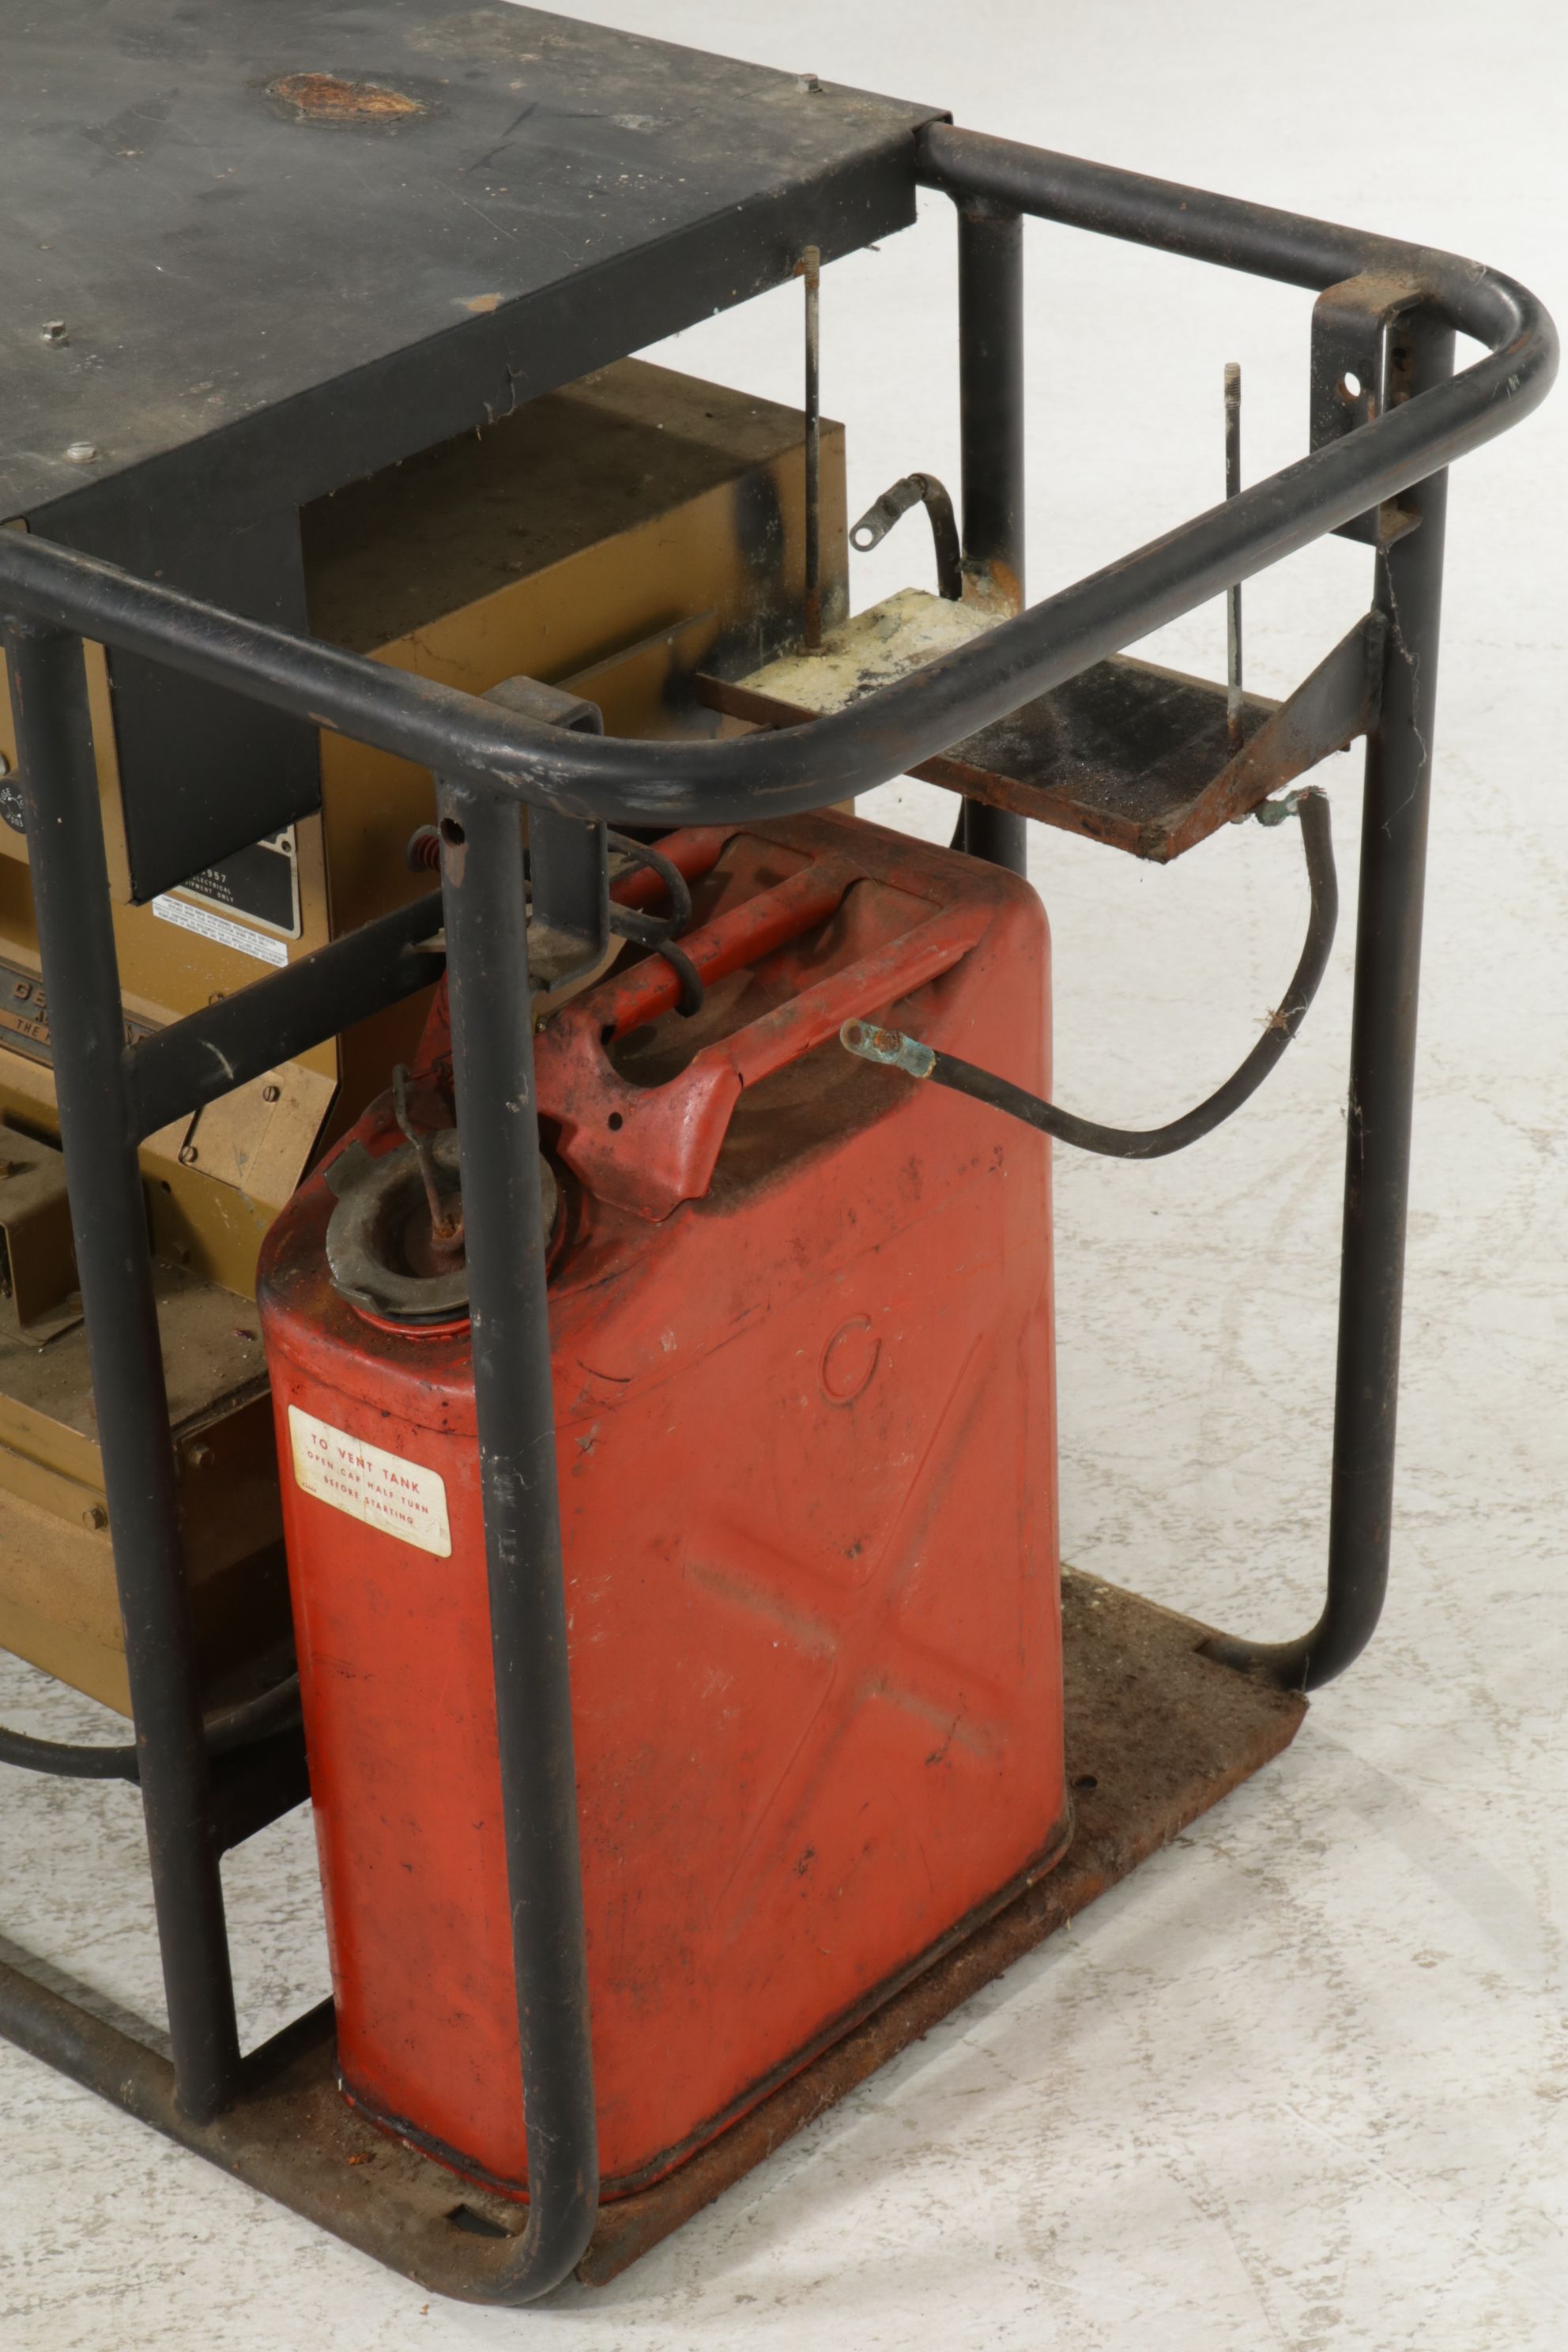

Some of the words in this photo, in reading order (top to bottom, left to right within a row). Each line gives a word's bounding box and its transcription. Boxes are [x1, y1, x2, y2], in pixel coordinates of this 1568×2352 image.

[217, 892, 234, 903] ONLY
[17, 1019, 40, 1037] THE
[307, 1450, 334, 1470] OPEN
[341, 1468, 360, 1483] CAP
[368, 1482, 394, 1498] HALF
[401, 1496, 428, 1514] TURN
[311, 1433, 329, 1450] TO
[338, 1447, 373, 1472] VENT
[383, 1468, 420, 1494] TANK
[324, 1475, 360, 1499] BEFORE
[365, 1496, 413, 1525] STARTING
